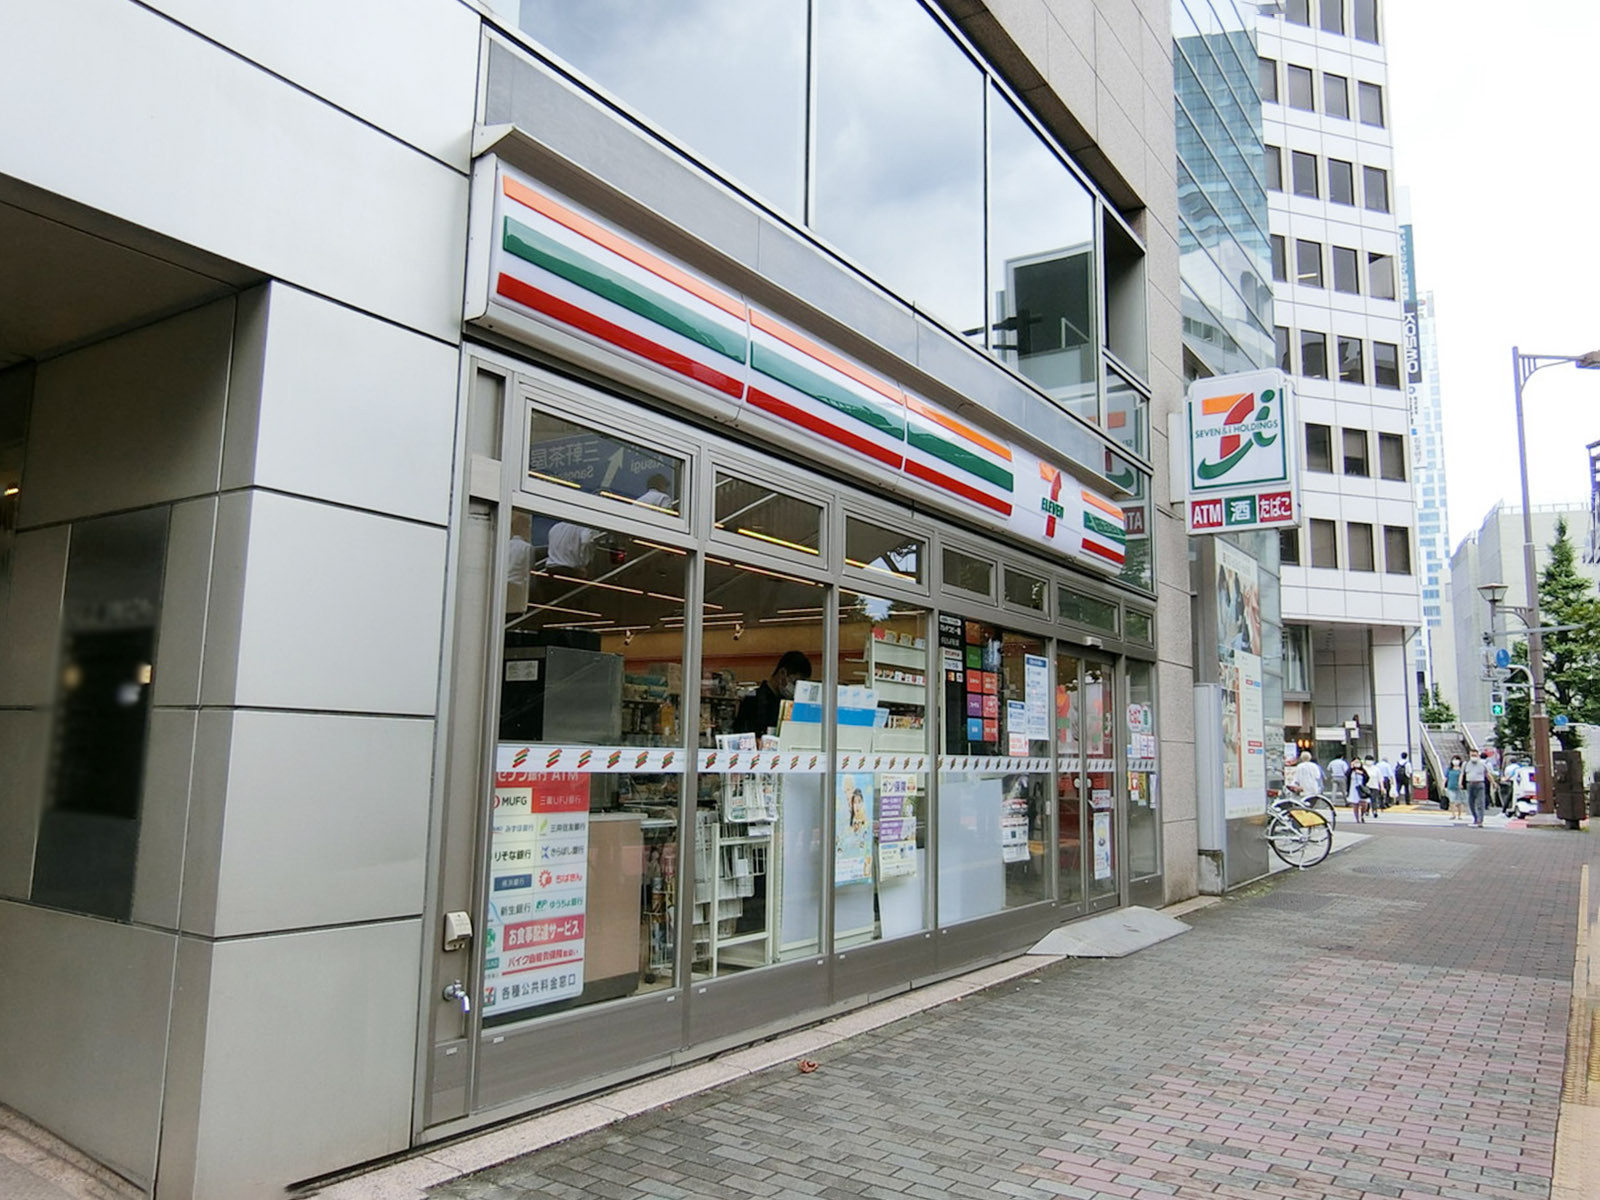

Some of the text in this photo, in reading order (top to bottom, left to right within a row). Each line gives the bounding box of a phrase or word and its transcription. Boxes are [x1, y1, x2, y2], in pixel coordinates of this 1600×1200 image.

[1233, 420, 1278, 433] HOLDINGS
[1193, 504, 1222, 524] ATM
[1230, 501, 1251, 522] 酒
[1259, 497, 1292, 518] たばこ
[501, 796, 528, 806] MUFG
[495, 849, 532, 862] りそな銀行
[501, 903, 531, 916] 新生銀行
[508, 920, 579, 946] お食事配達サービス
[502, 974, 576, 1000] 各種公共料金窓口
